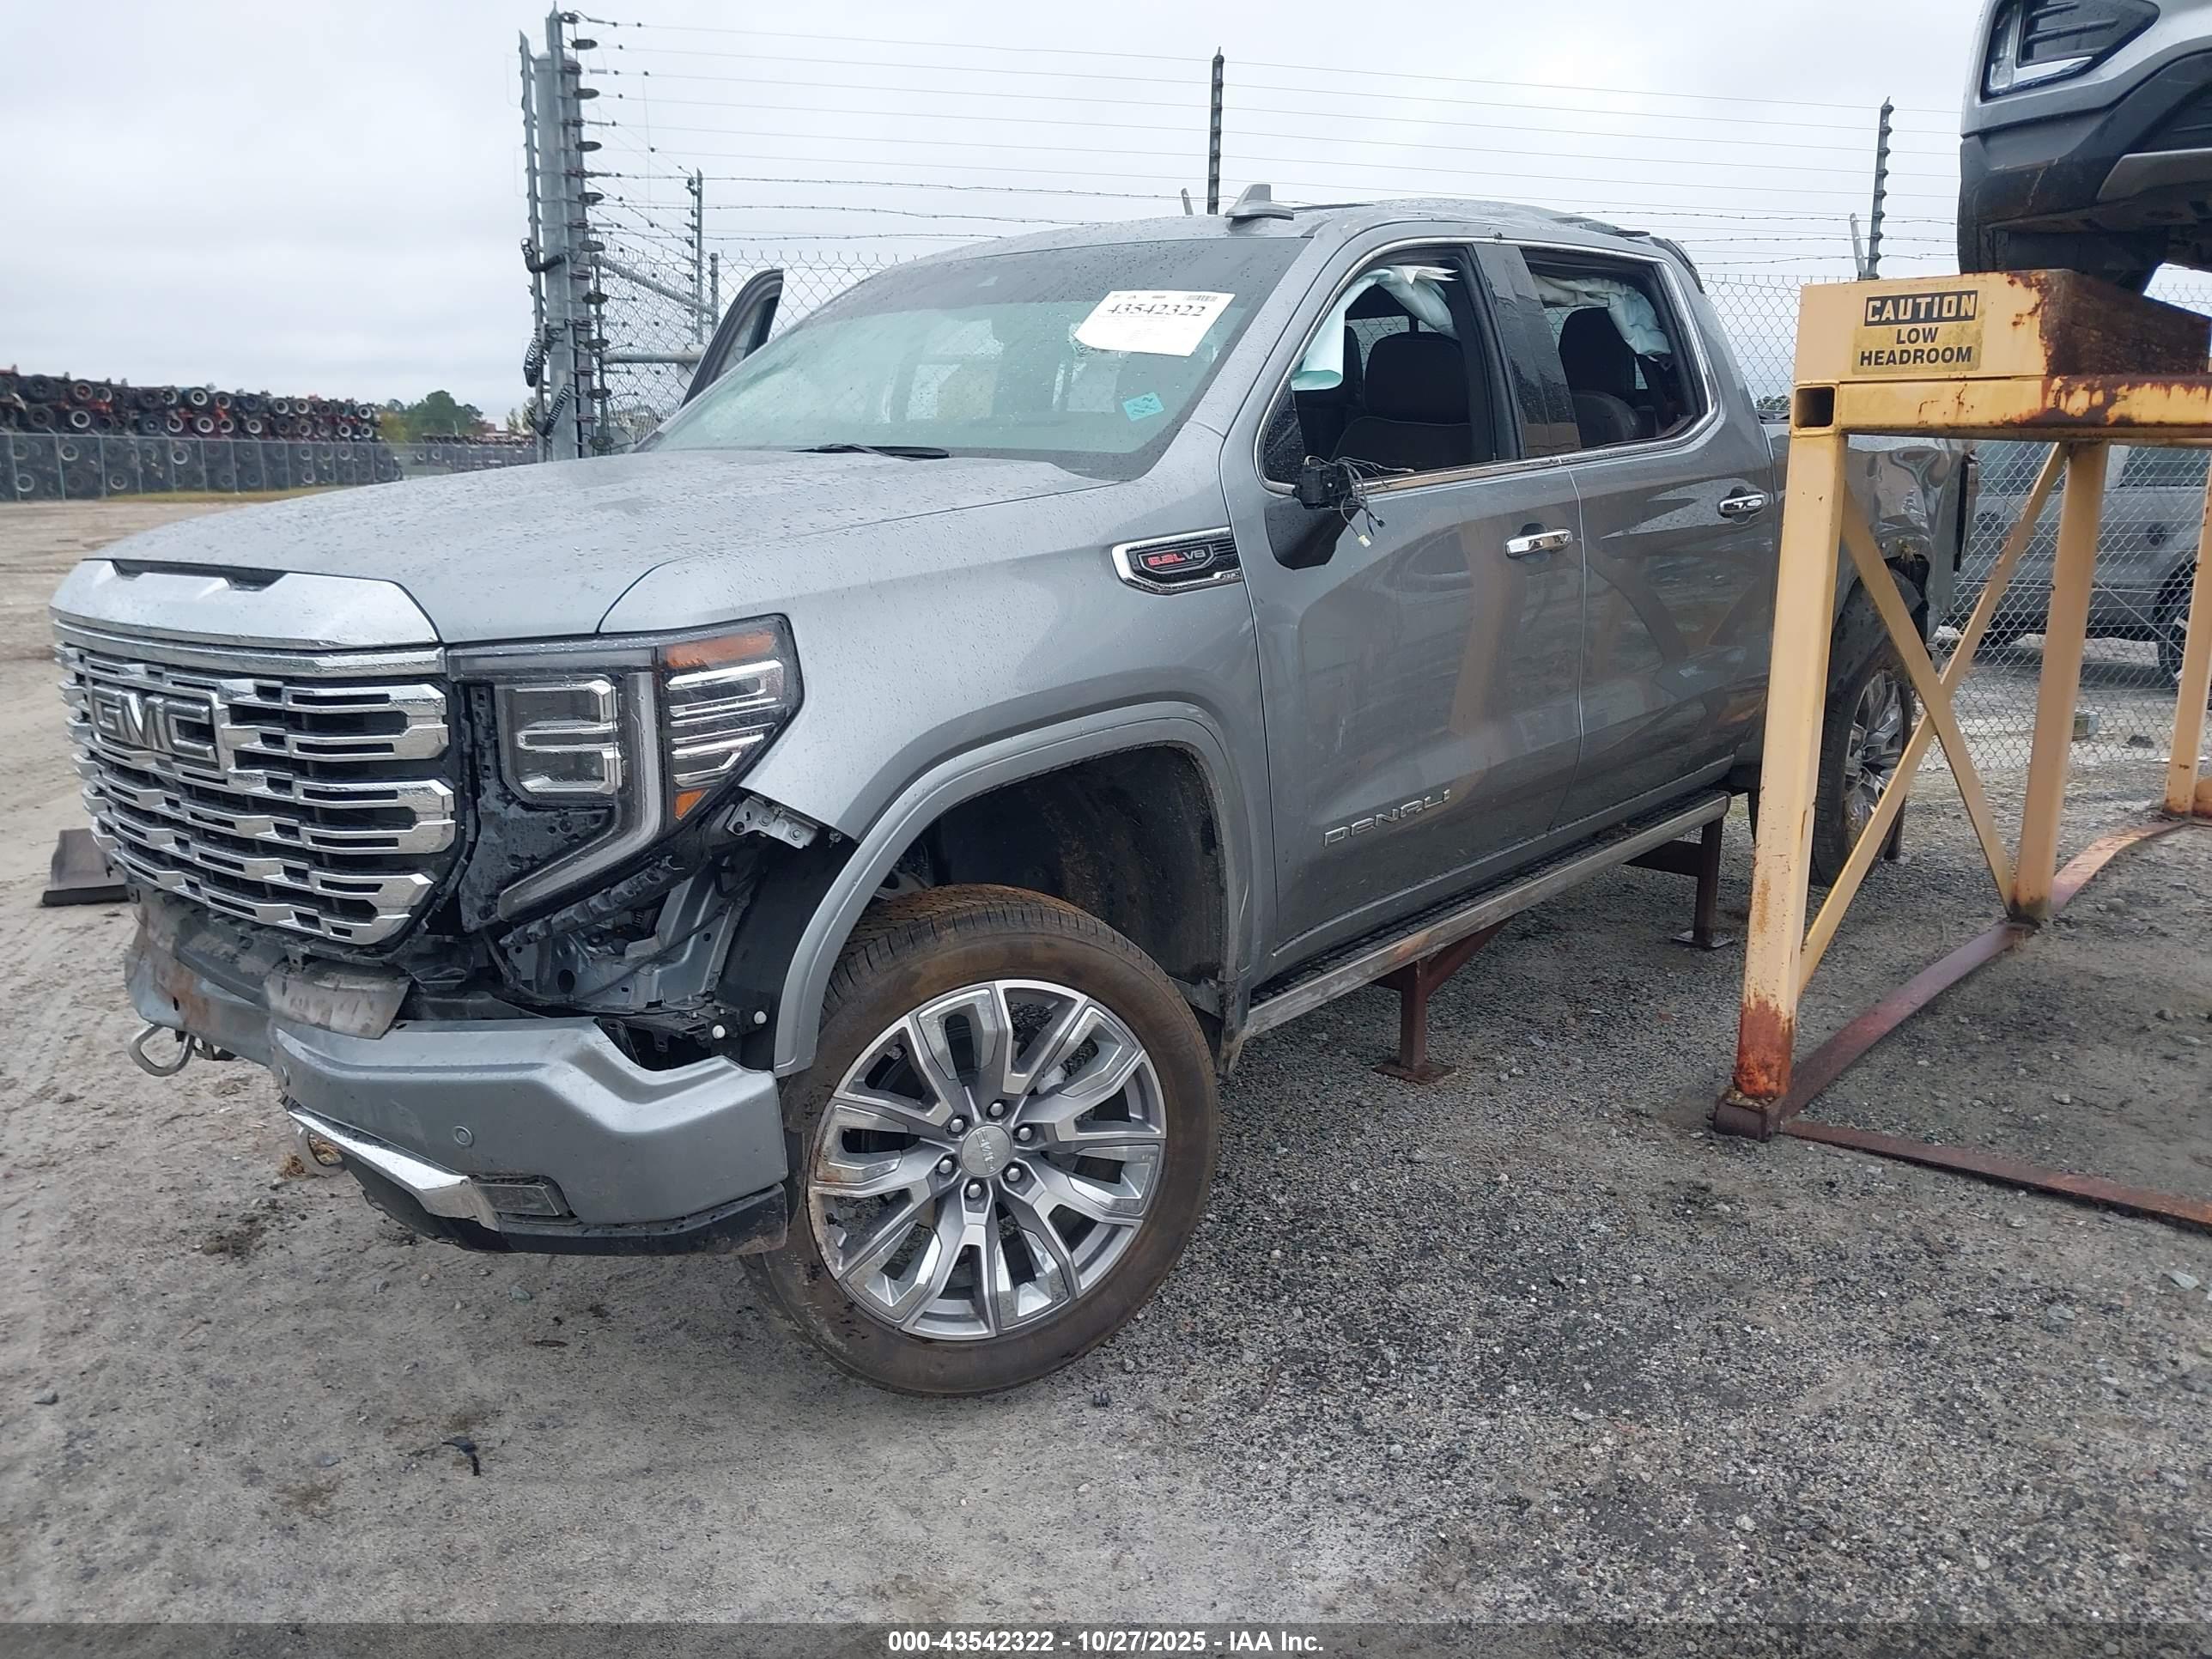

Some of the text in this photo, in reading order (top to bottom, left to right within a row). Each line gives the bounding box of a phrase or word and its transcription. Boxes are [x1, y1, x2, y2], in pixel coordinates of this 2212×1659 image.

[1107, 303, 1206, 317] 43542322
[1866, 294, 1977, 322] CAUTION
[1896, 327, 1939, 344] LOW
[1859, 346, 1972, 367] HEADROOM
[90, 685, 215, 762] GMC
[1323, 788, 1450, 848] DENALI
